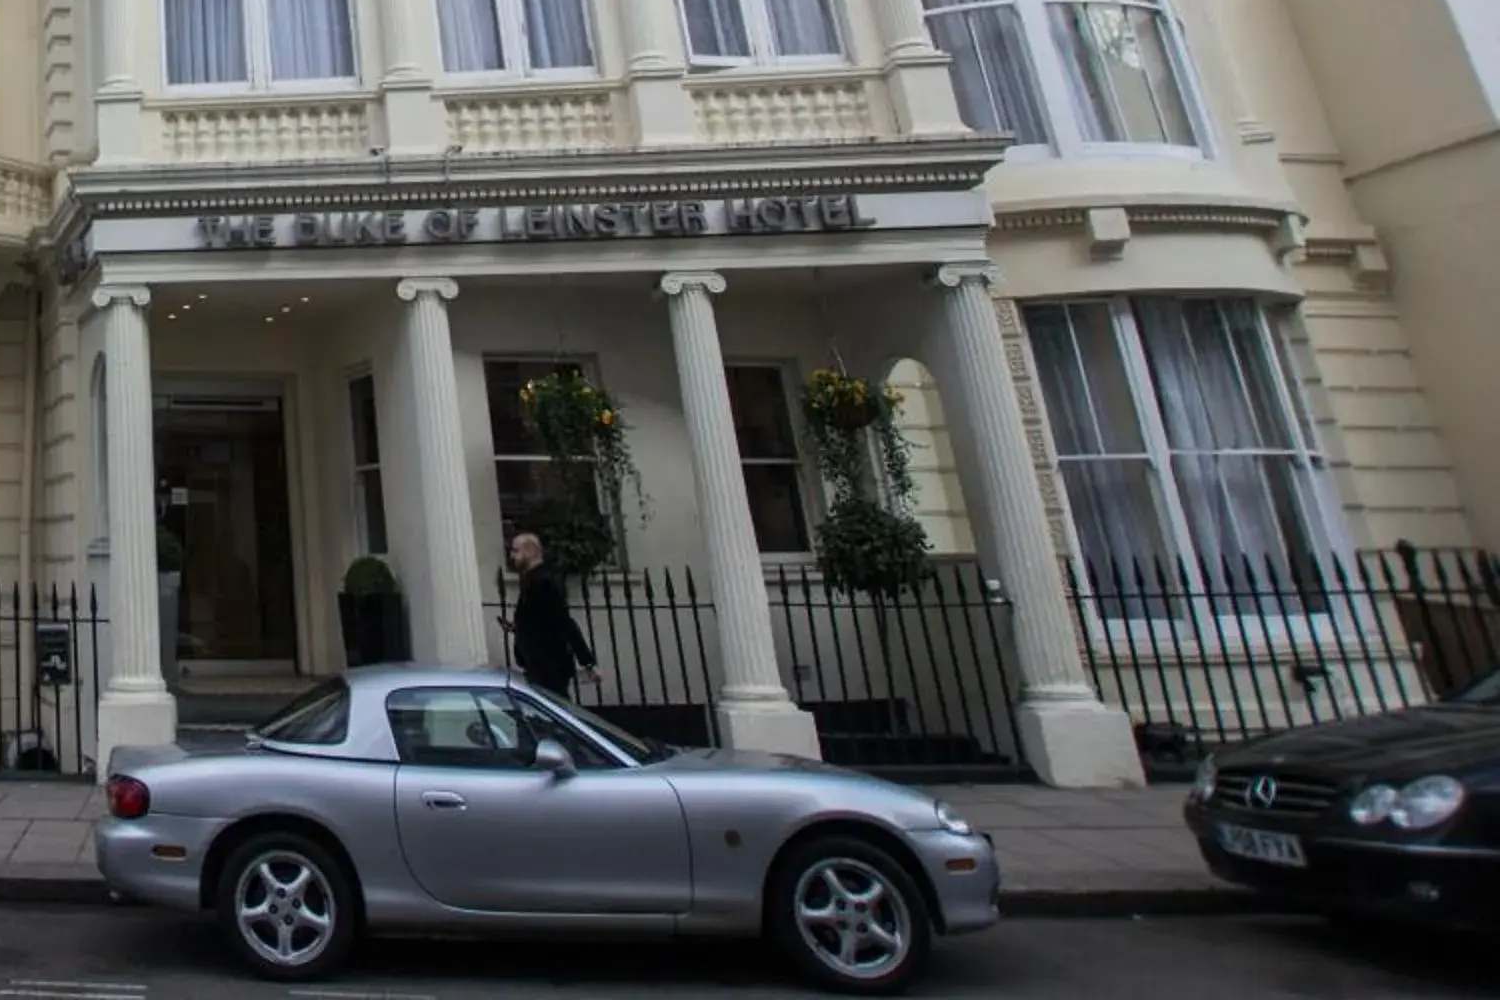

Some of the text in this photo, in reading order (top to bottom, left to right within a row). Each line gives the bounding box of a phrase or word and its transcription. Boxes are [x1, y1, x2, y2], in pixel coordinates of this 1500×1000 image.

[196, 194, 878, 247] THE DUKE OF LEINSTER HOTEL
